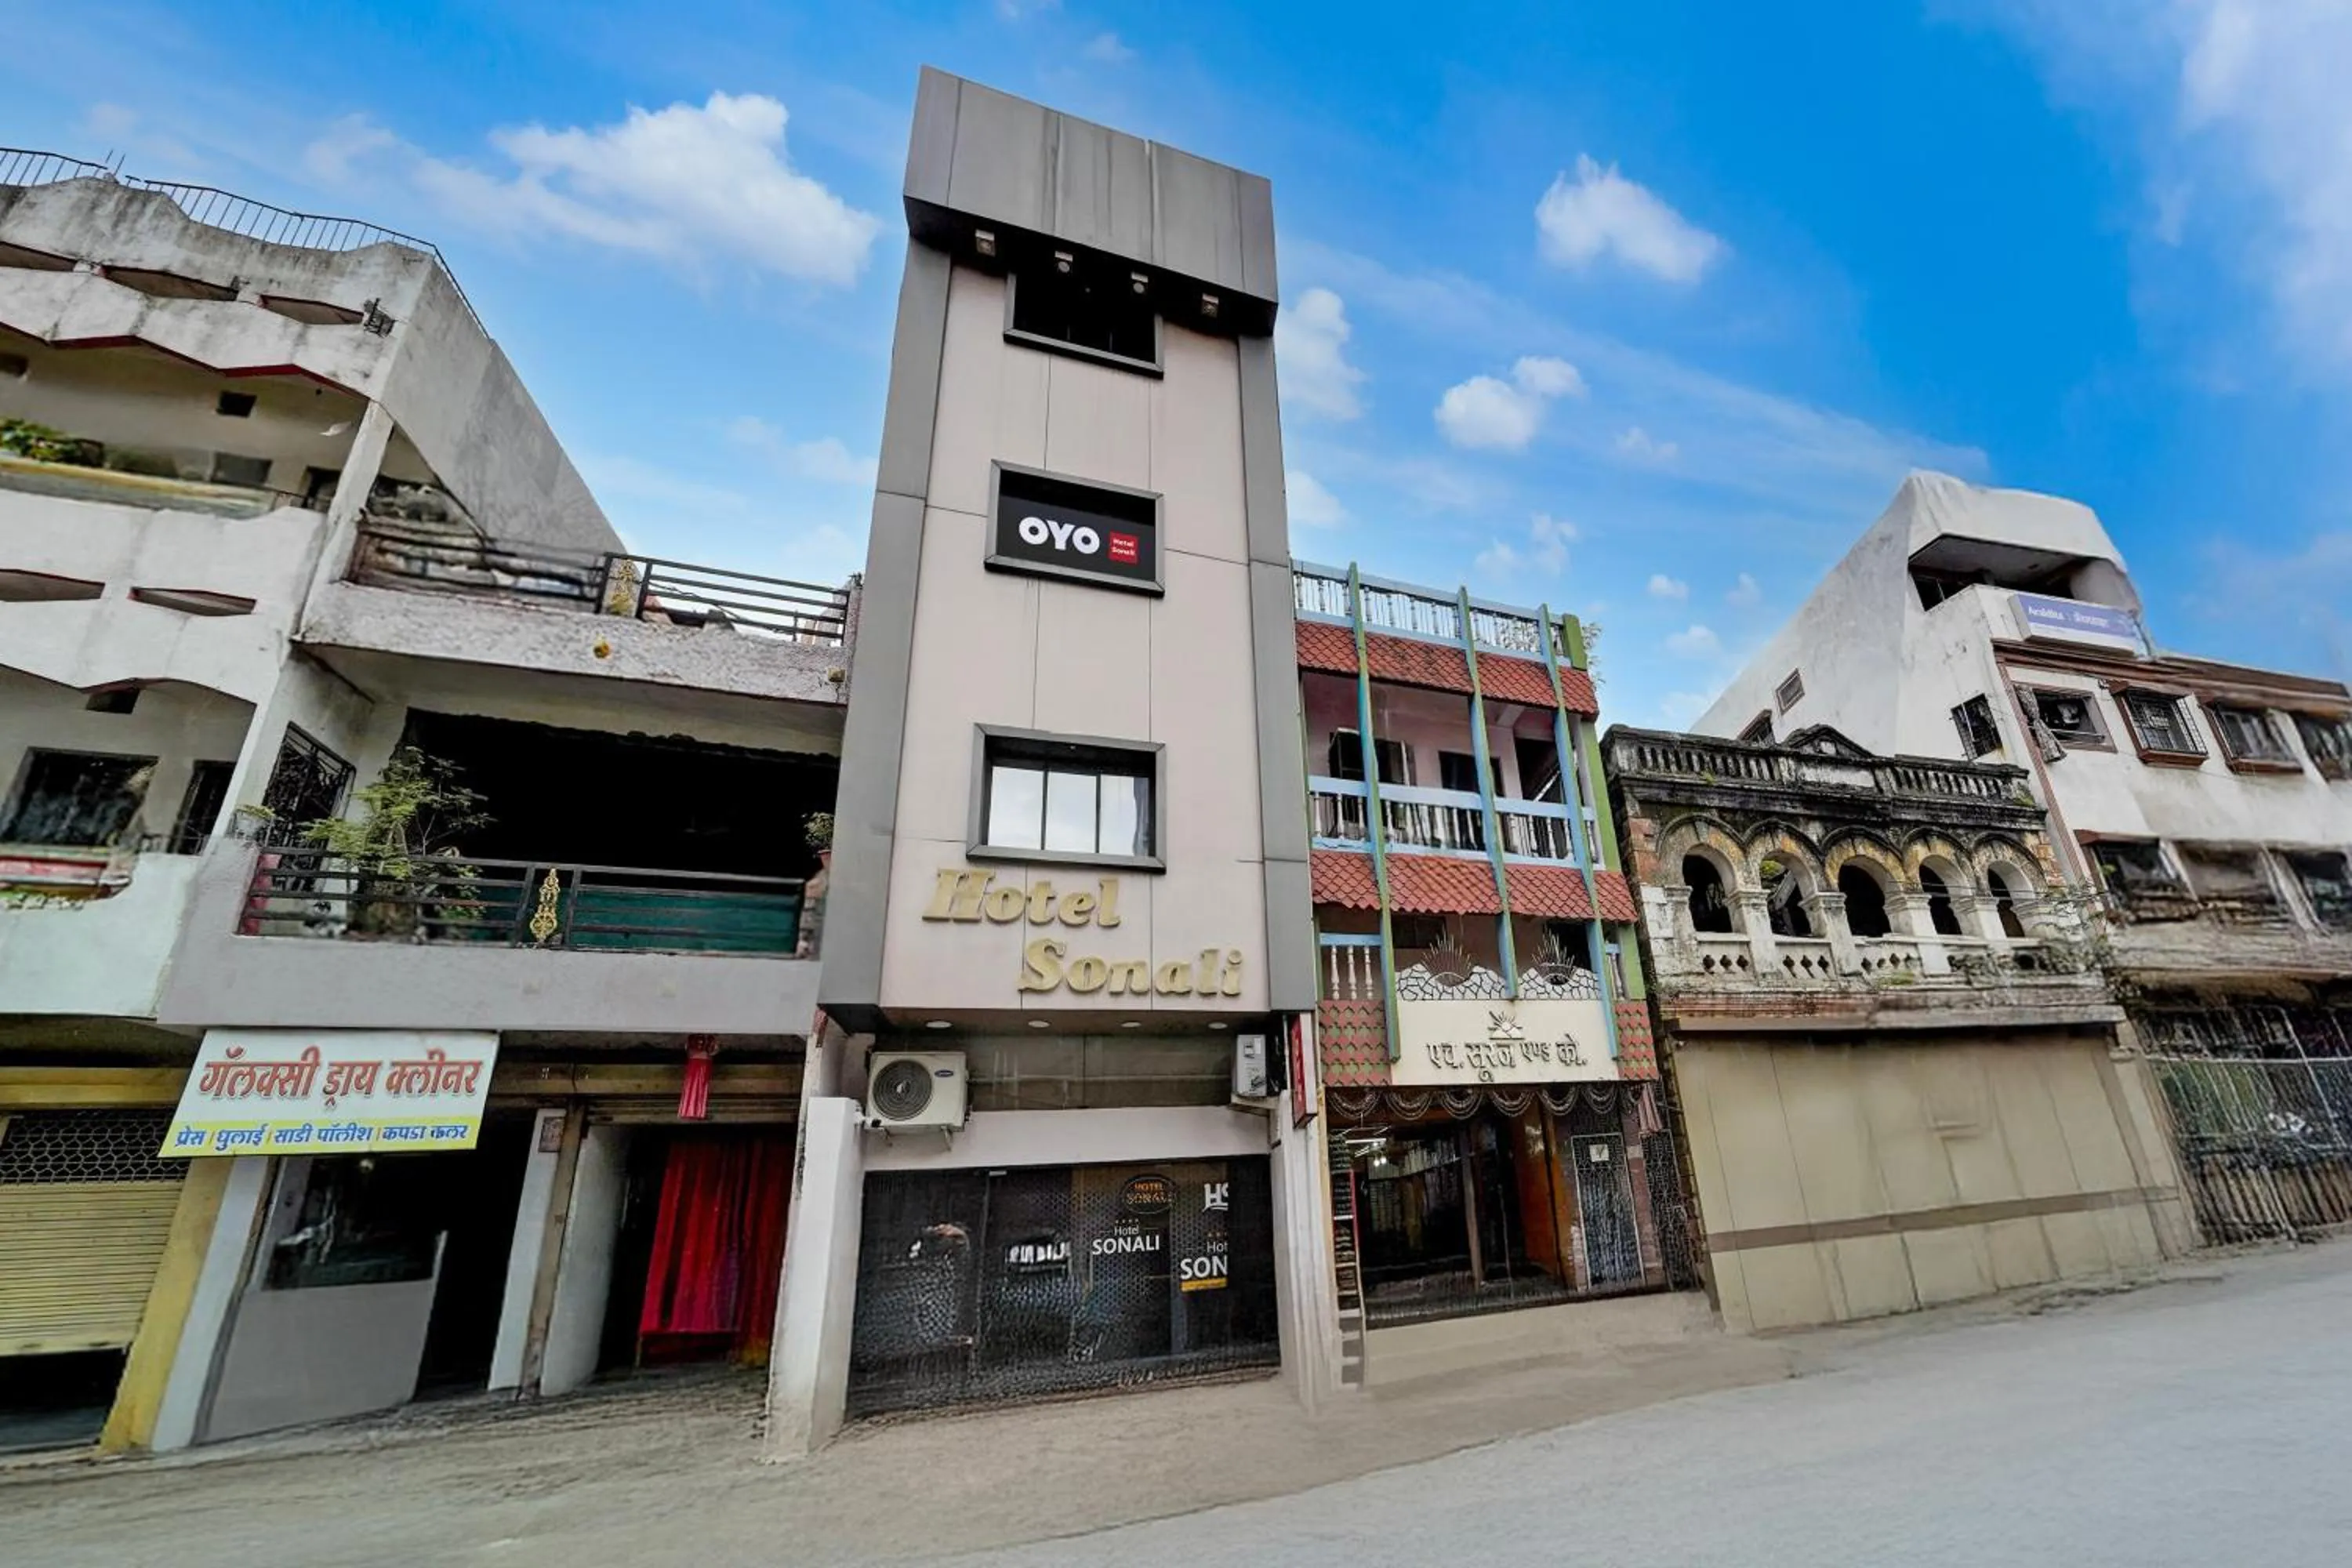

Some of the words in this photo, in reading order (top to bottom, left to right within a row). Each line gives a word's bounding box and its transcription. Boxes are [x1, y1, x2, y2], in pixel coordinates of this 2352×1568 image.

[1018, 516, 1100, 554] OYO
[922, 868, 1121, 928] Hotel
[1017, 938, 1243, 997] Sonali
[385, 1047, 483, 1095] क्लीनर
[175, 1126, 207, 1146] प्रेस
[216, 1123, 268, 1151] धुलाई
[274, 1123, 314, 1143] साडी
[317, 1121, 373, 1142] पॉलीश
[1092, 1235, 1160, 1255] SONALI
[1114, 1225, 1140, 1236] Hotel
[1180, 1255, 1229, 1279] SON
